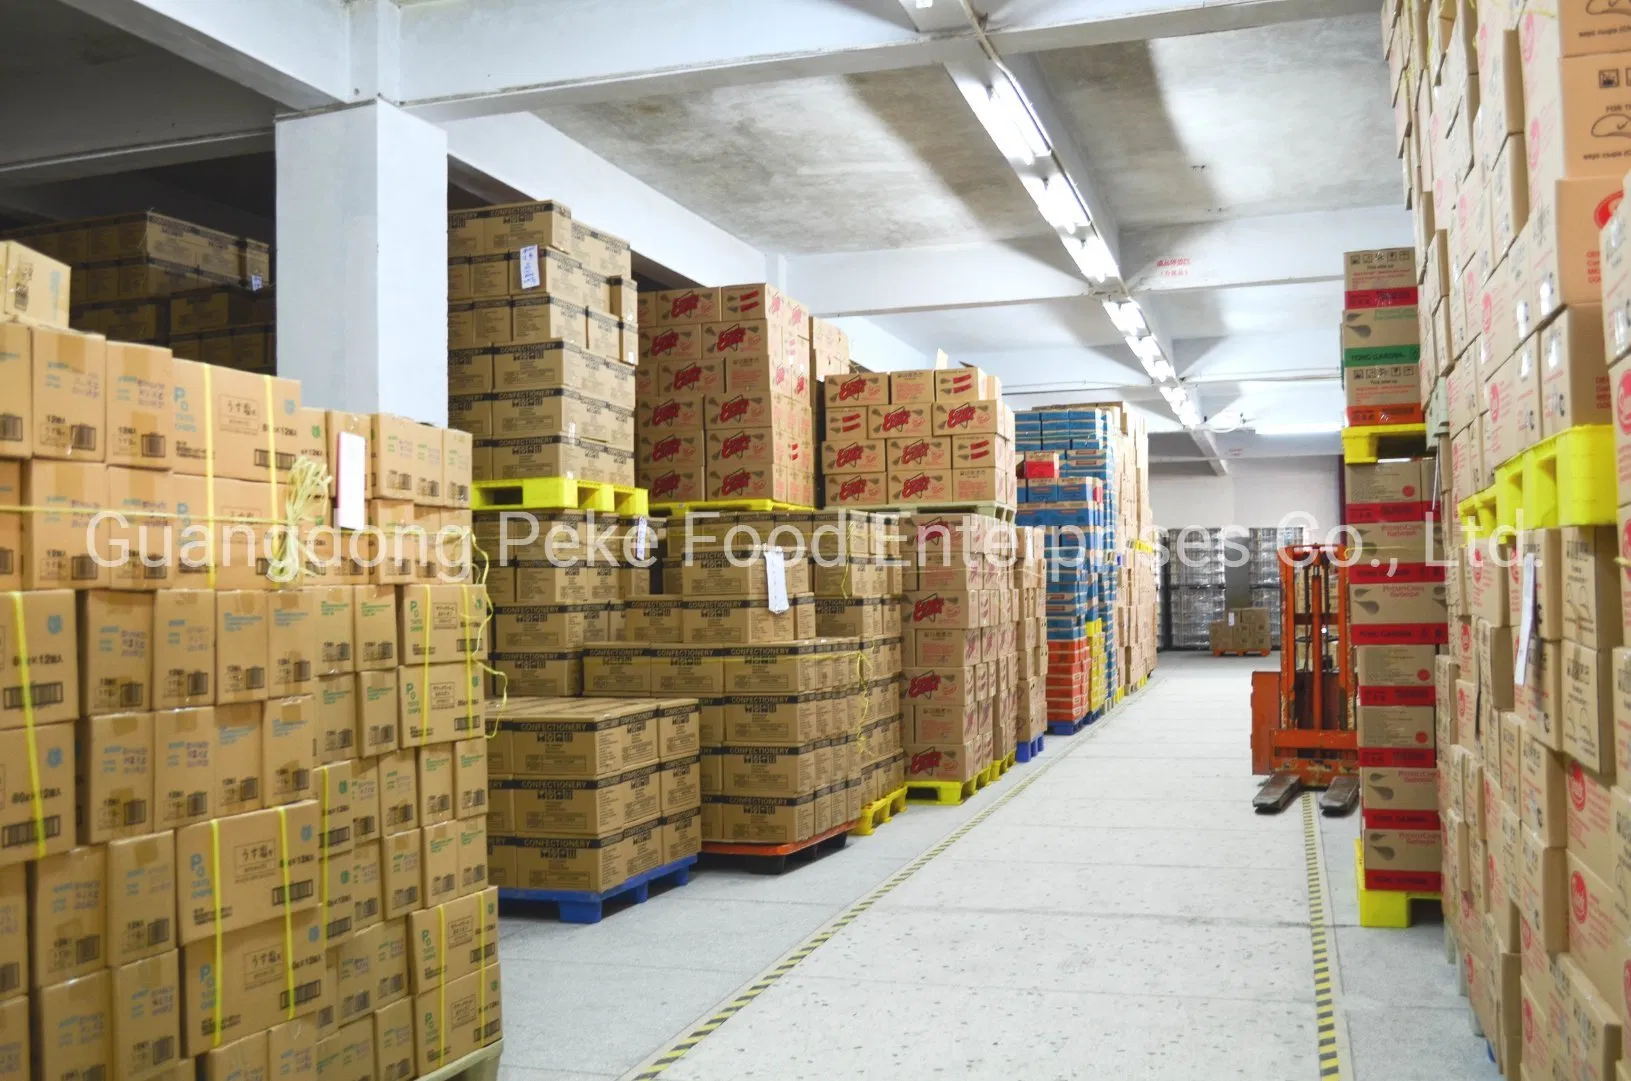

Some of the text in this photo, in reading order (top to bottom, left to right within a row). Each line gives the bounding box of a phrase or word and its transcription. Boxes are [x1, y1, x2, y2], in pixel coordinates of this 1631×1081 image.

[520, 722, 588, 732] CONFECTIONERY
[521, 780, 588, 790] CONFECTIONERY
[523, 839, 591, 849] CONFECTIONERY
